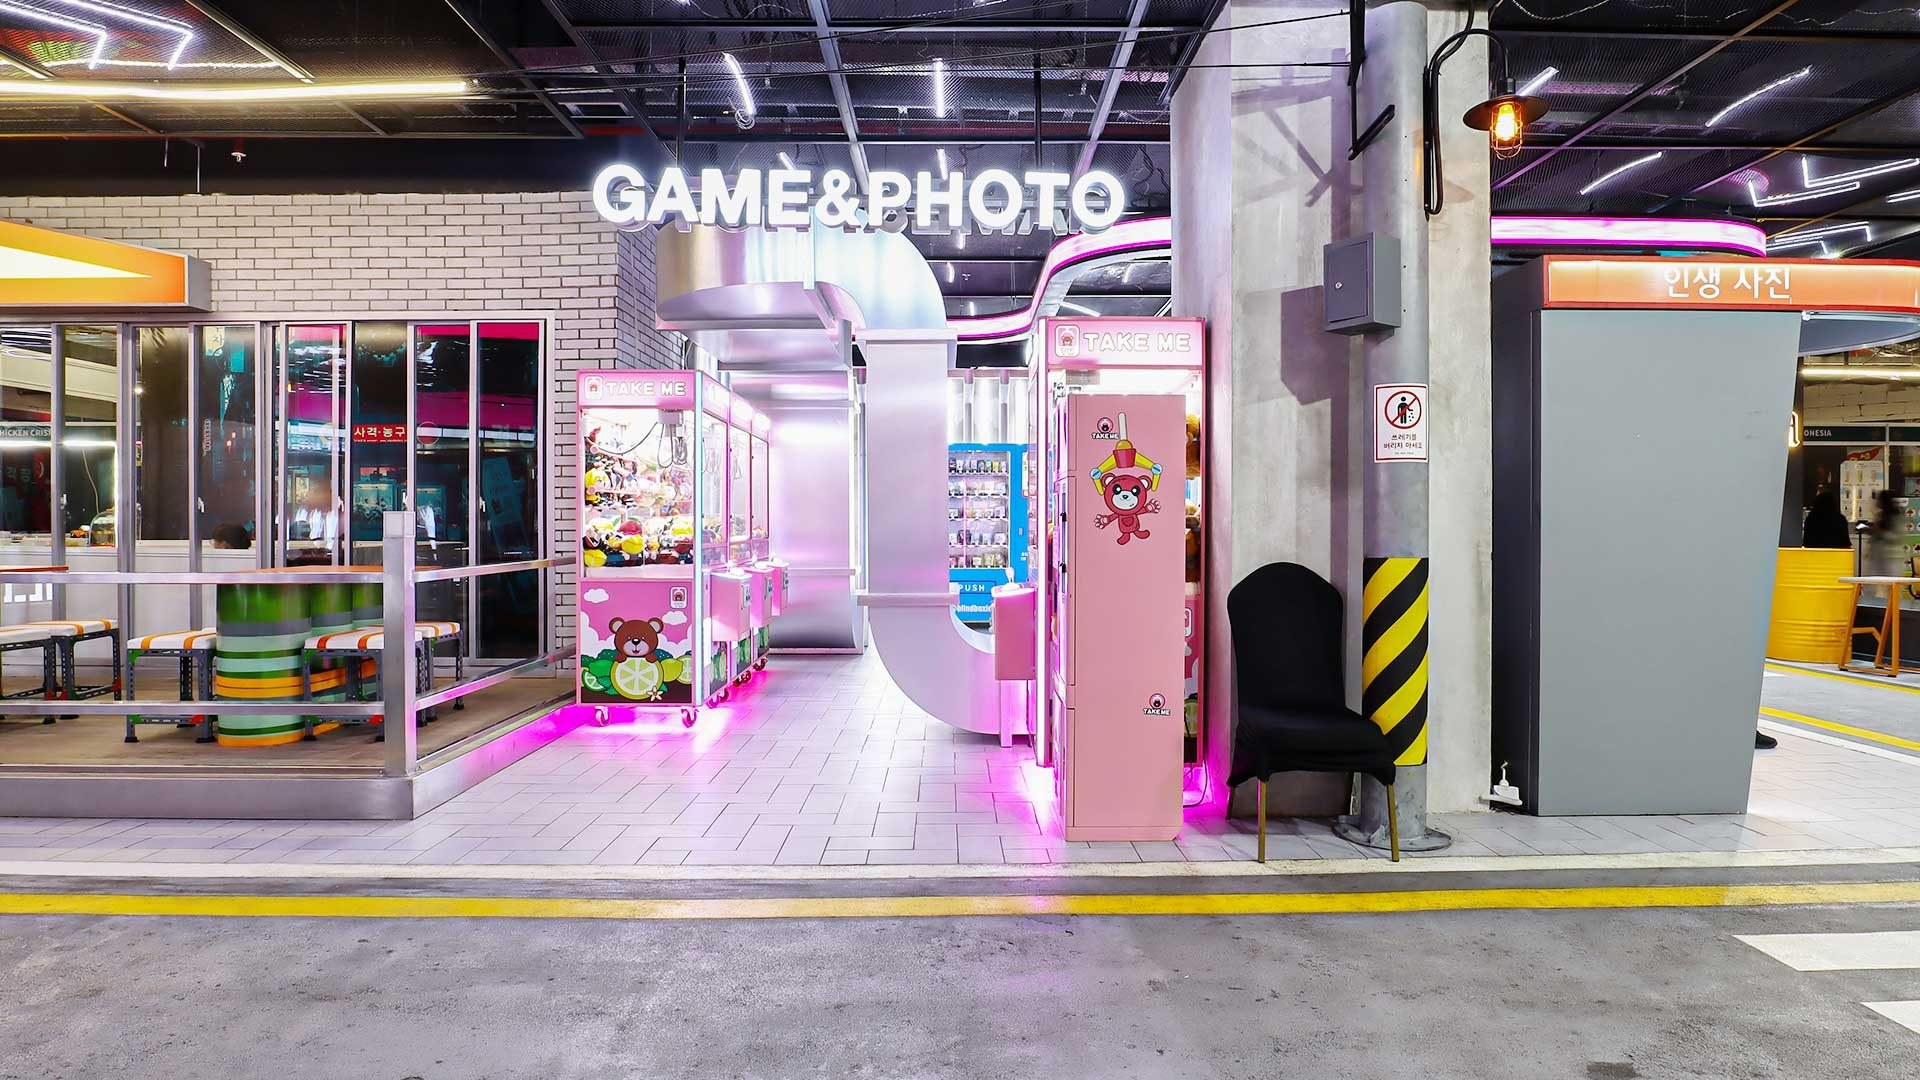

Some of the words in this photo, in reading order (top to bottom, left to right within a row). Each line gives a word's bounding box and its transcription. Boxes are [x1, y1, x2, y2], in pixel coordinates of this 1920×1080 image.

[592, 164, 1125, 228] GAME&PHOTO
[1663, 266, 1721, 299] 인생
[1733, 266, 1790, 299] 사진
[1083, 332, 1151, 352] TAKE
[1156, 332, 1192, 352] ME
[605, 381, 656, 396] TAKE
[660, 381, 687, 397] ME
[1091, 432, 1109, 440] TAKE
[1143, 708, 1160, 716] TAKE
[1160, 708, 1171, 717] ME
